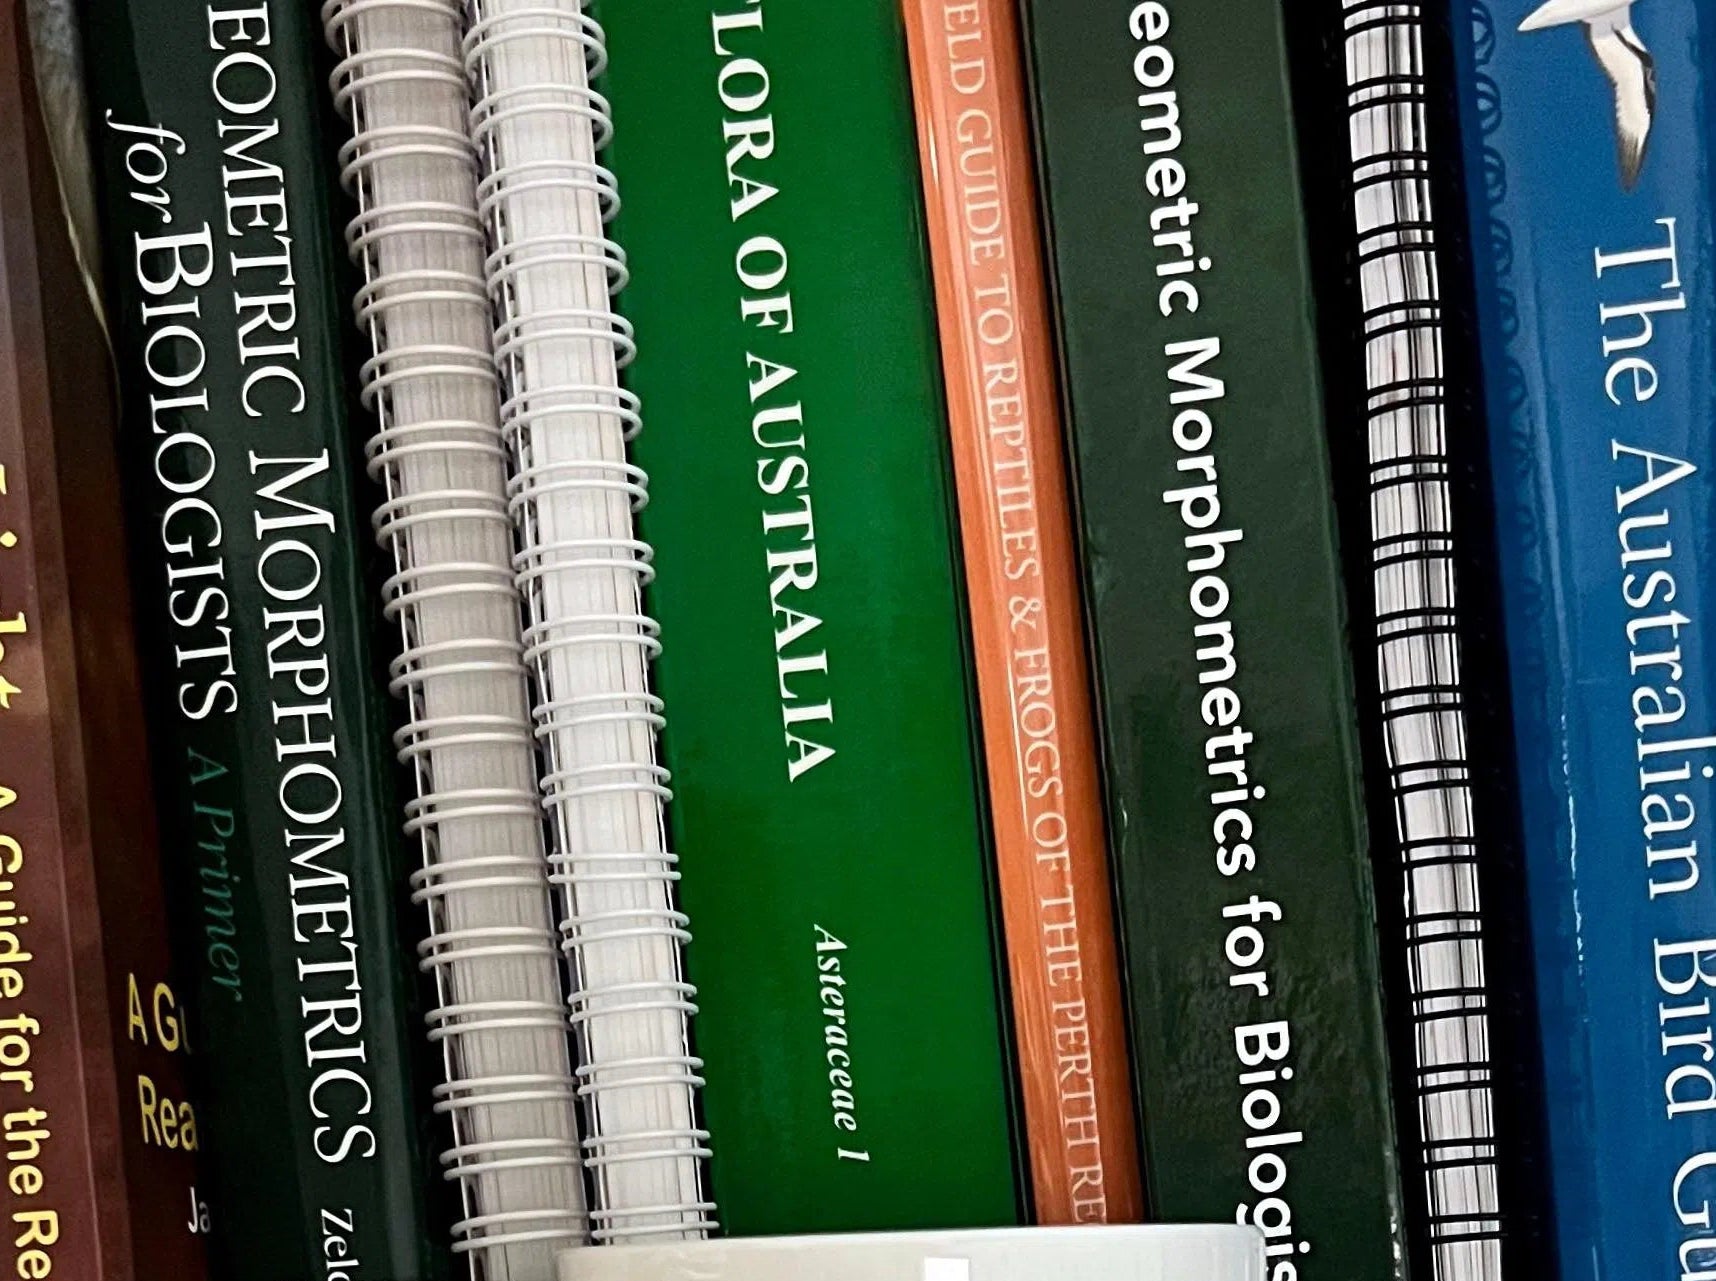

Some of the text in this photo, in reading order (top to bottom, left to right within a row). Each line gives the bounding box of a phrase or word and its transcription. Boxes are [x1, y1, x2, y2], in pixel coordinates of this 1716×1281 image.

[1129, 1, 1212, 317] eometric
[711, 0, 836, 783] LORA OF AUSTRALIA
[1595, 217, 1687, 406] The
[105, 108, 243, 1002] for BIOLOGISTS A Primer
[206, 1, 377, 1164] EOMETRIC MORPHOMETRICS
[943, 2, 1107, 1225] ELD GUIDE TO REPTILES & FROGS OF THE PERTH RE
[1163, 336, 1266, 876] Morphometrics
[1611, 437, 1716, 900] Australian
[128, 972, 148, 1045] A
[813, 922, 859, 1133] Asteraceae
[1222, 895, 1281, 998] for
[1653, 937, 1716, 1120] Bird
[0, 1013, 40, 1093] for
[3, 1107, 50, 1196] the
[138, 1074, 199, 1150] Rea
